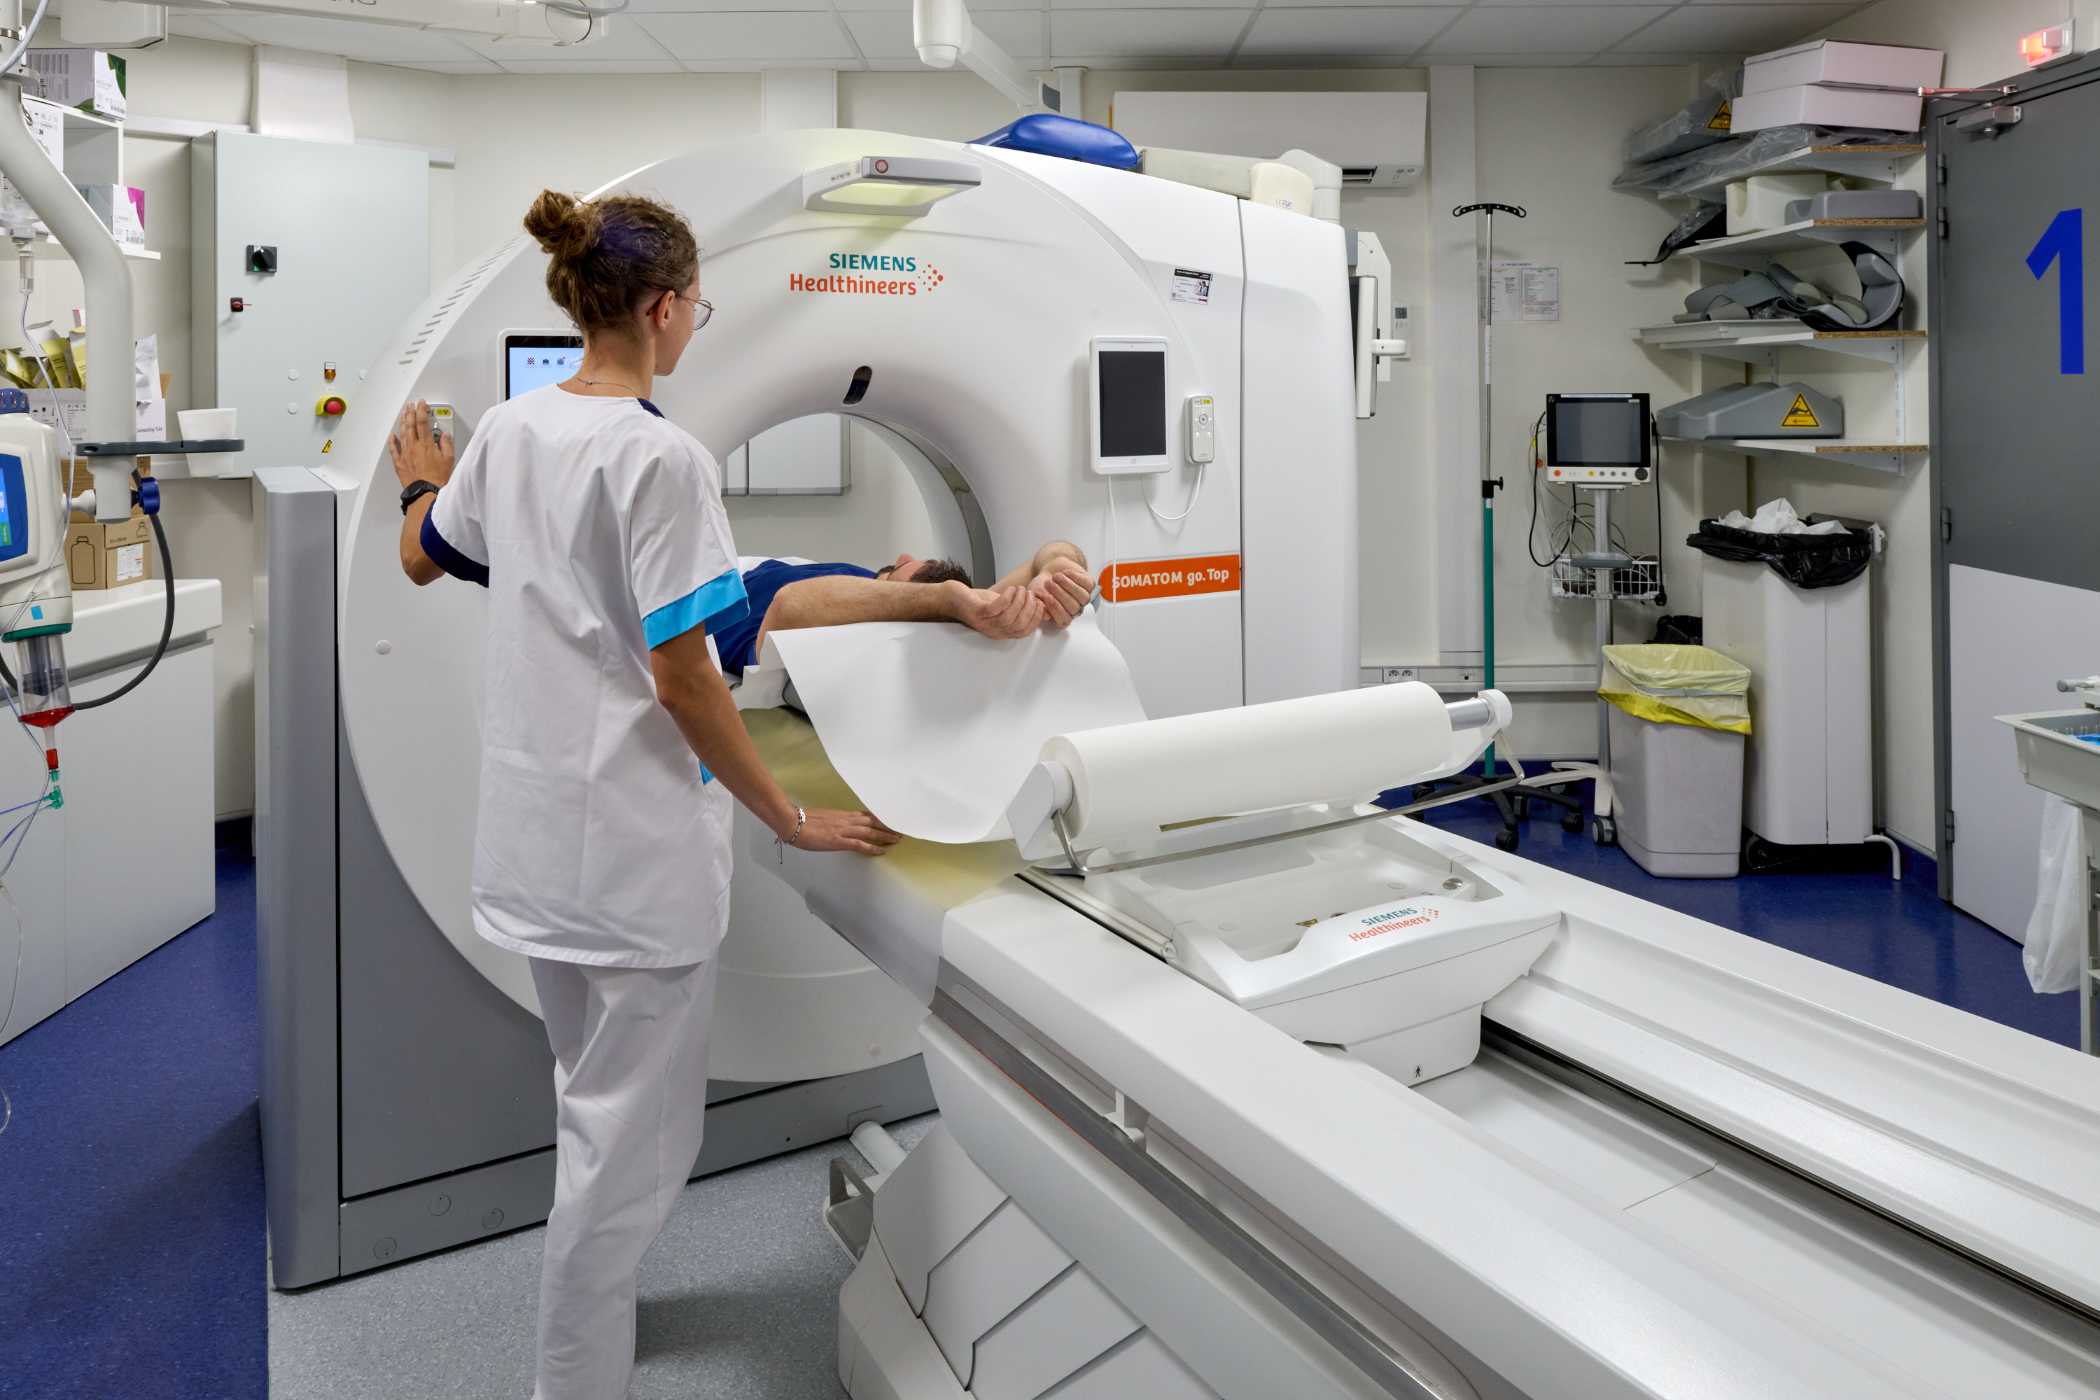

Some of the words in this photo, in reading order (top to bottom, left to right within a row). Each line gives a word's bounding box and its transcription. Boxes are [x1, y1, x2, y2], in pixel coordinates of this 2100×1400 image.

[829, 252, 917, 273] SIEMENS
[790, 272, 917, 296] Healthineers
[2026, 208, 2085, 375] 1
[1112, 571, 1183, 589] SOMATOM
[1361, 907, 1419, 926] SIEMENS
[1348, 915, 1431, 942] Healthineers
